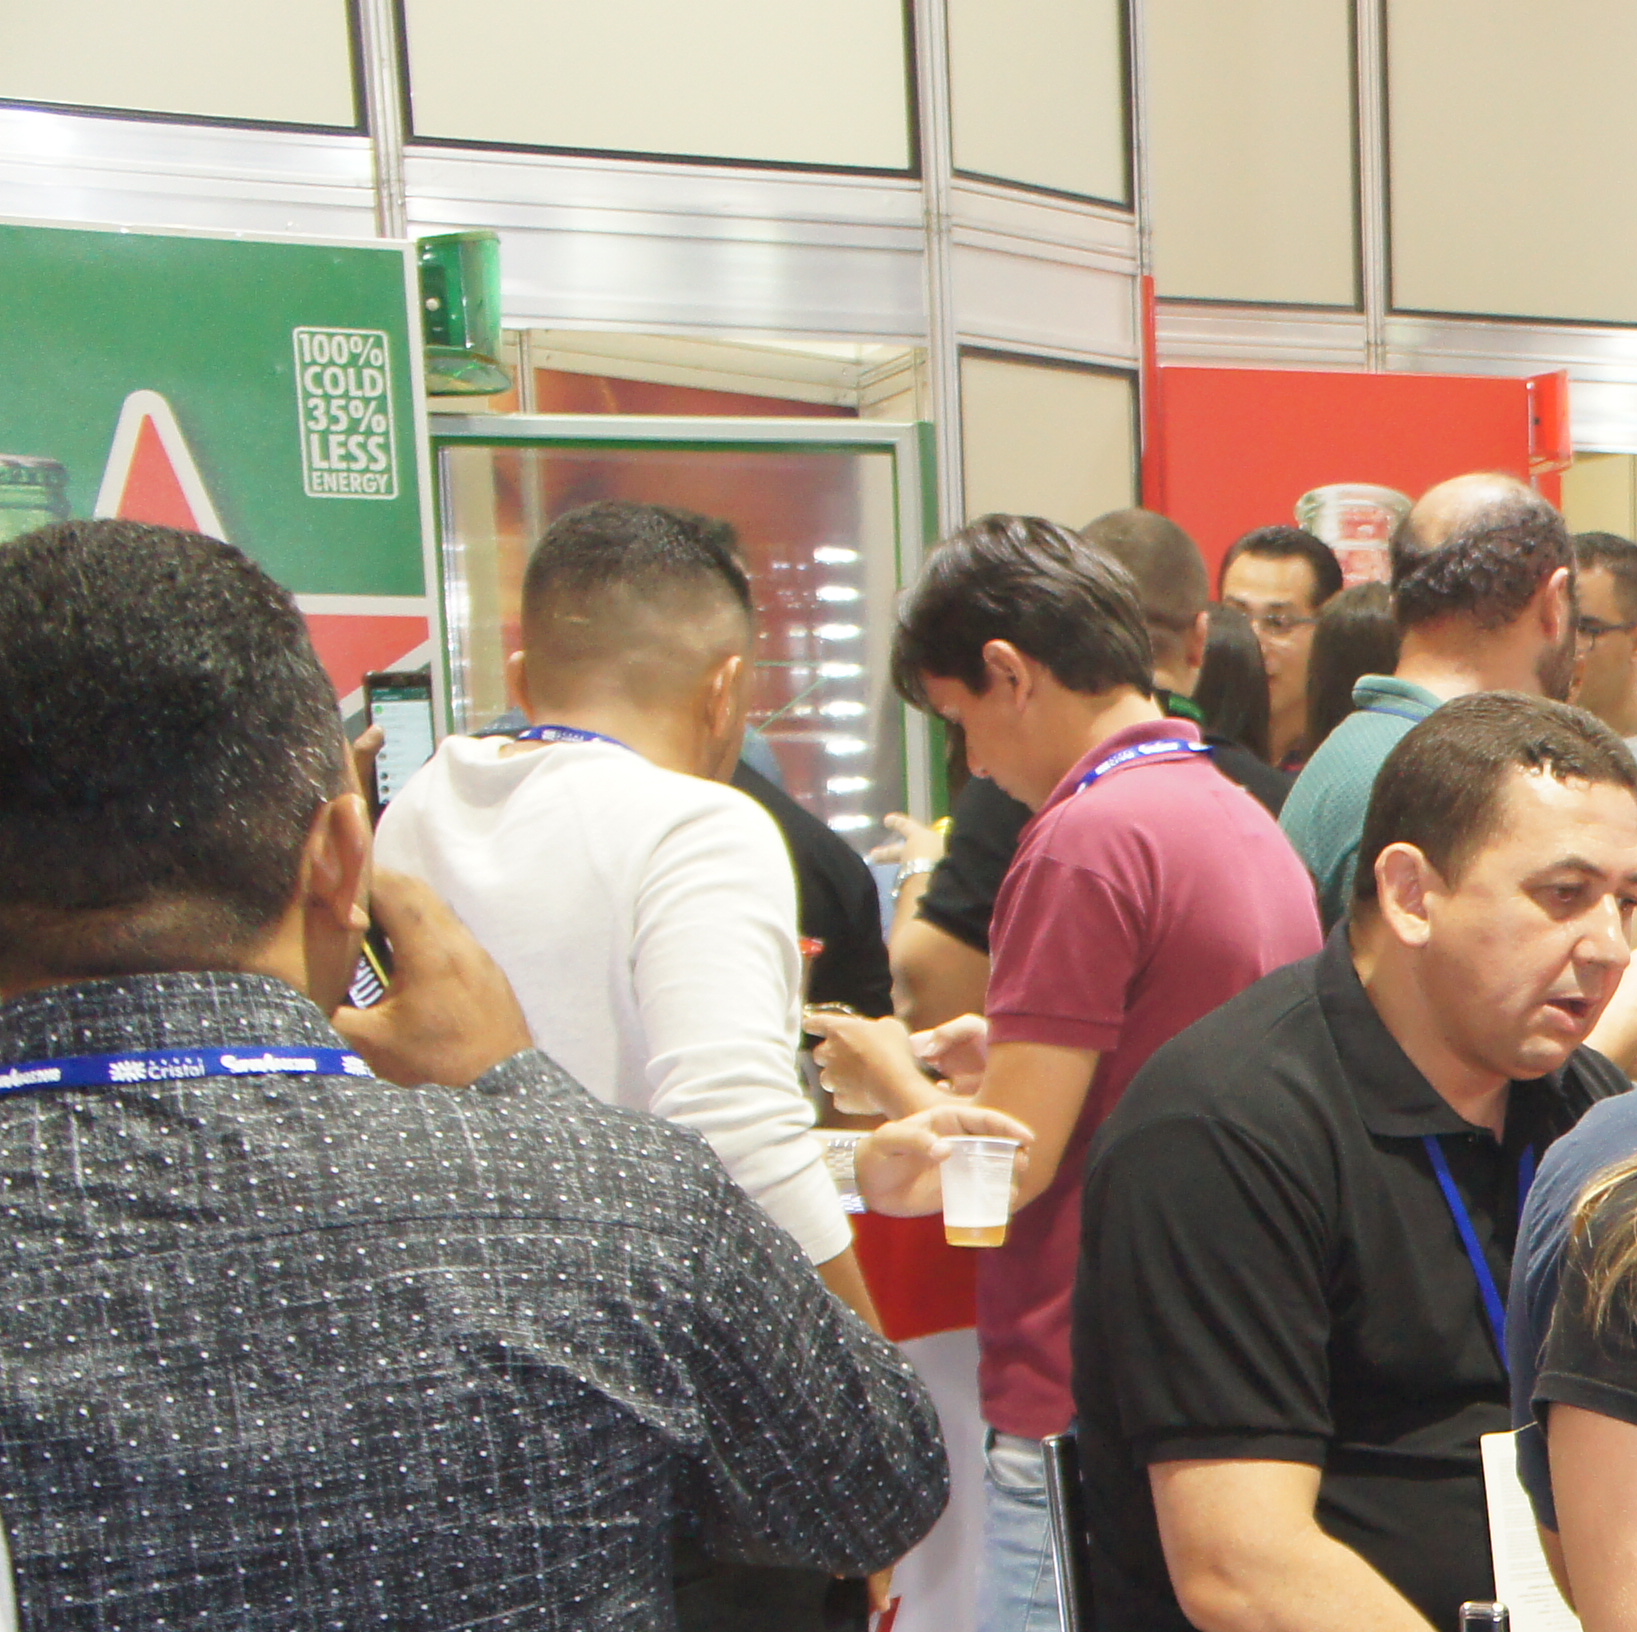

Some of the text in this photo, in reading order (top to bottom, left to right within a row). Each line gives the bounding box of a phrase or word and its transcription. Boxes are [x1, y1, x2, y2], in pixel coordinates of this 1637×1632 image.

[299, 333, 384, 367] 100%
[303, 365, 384, 398] COLD
[307, 397, 387, 433] 35%
[310, 433, 388, 472] LESS
[311, 471, 390, 494] ENERGY
